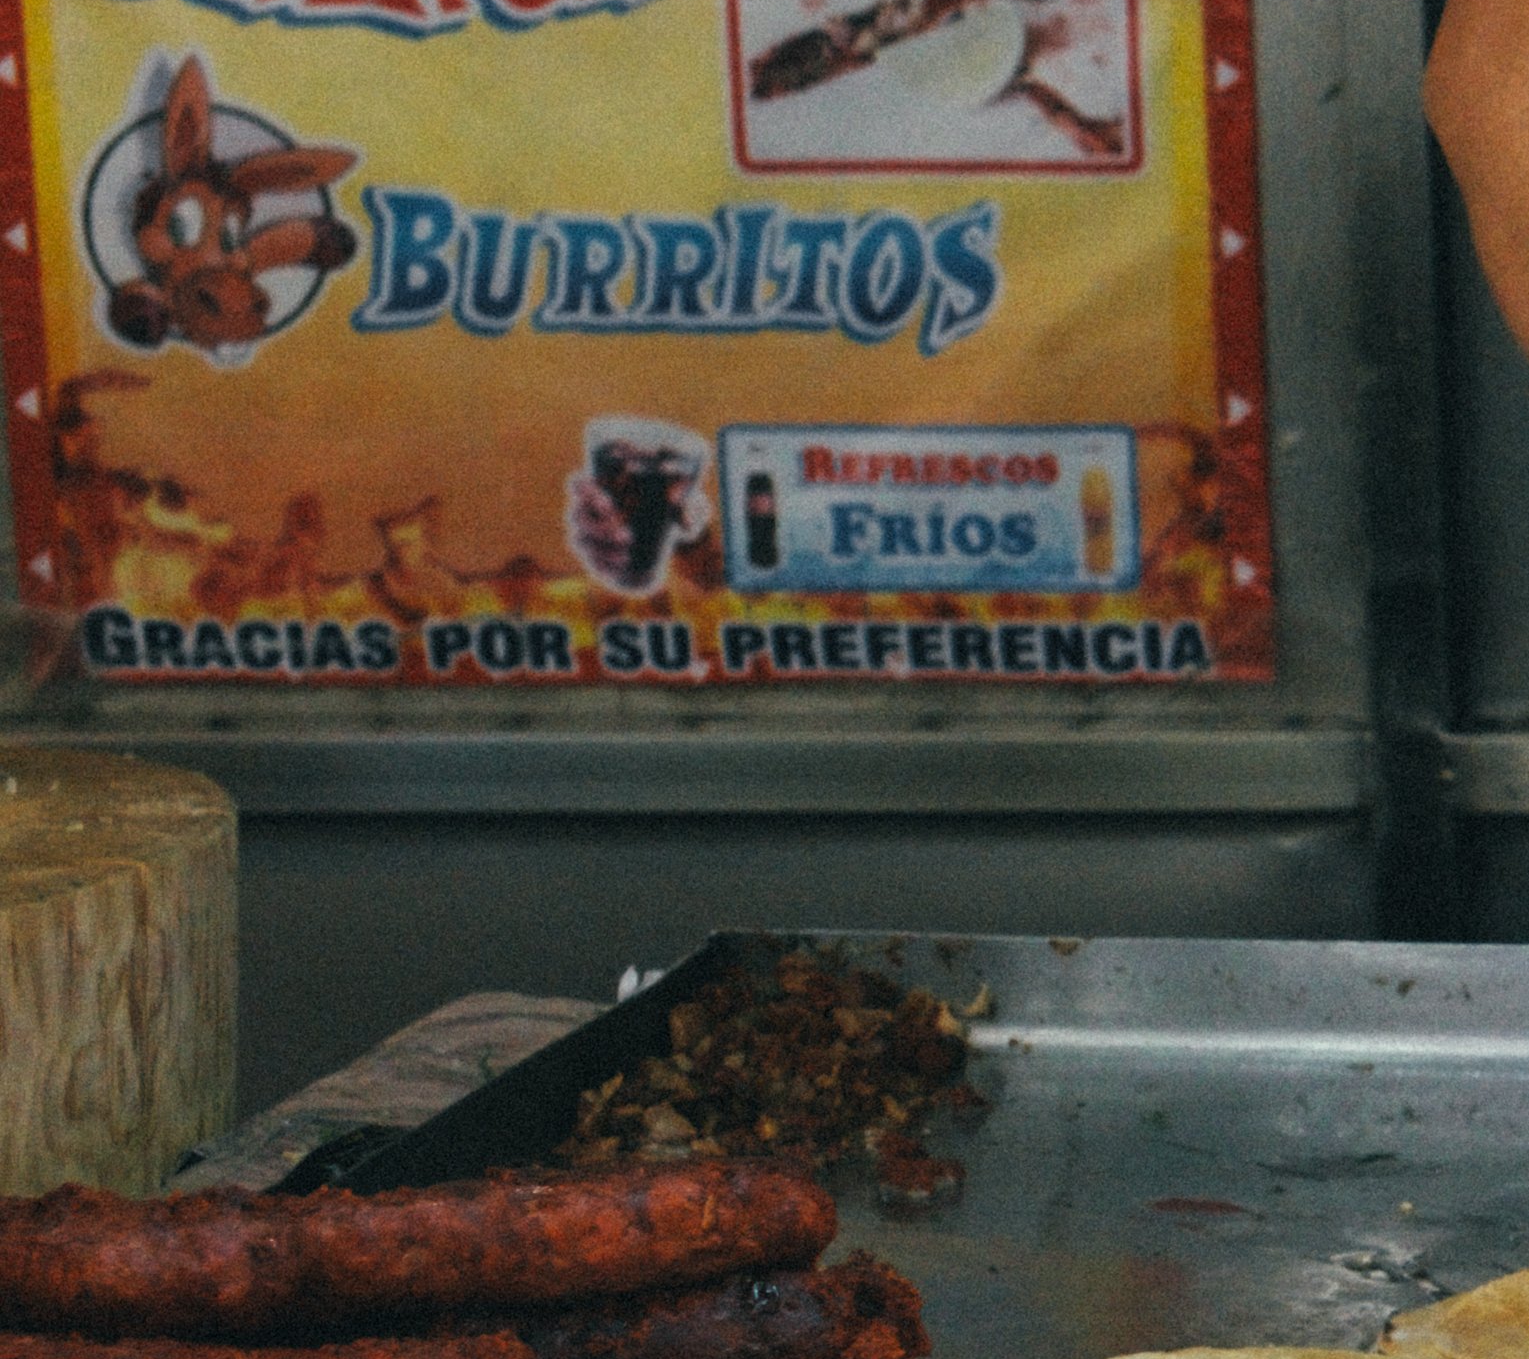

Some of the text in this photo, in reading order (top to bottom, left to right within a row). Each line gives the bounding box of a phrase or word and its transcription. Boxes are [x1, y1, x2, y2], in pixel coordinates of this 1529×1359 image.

[358, 187, 1001, 351] BURRITOS
[802, 444, 1061, 486] REFRESCOS
[82, 607, 1211, 676] GRACIAS POR SU PREFERENCIA
